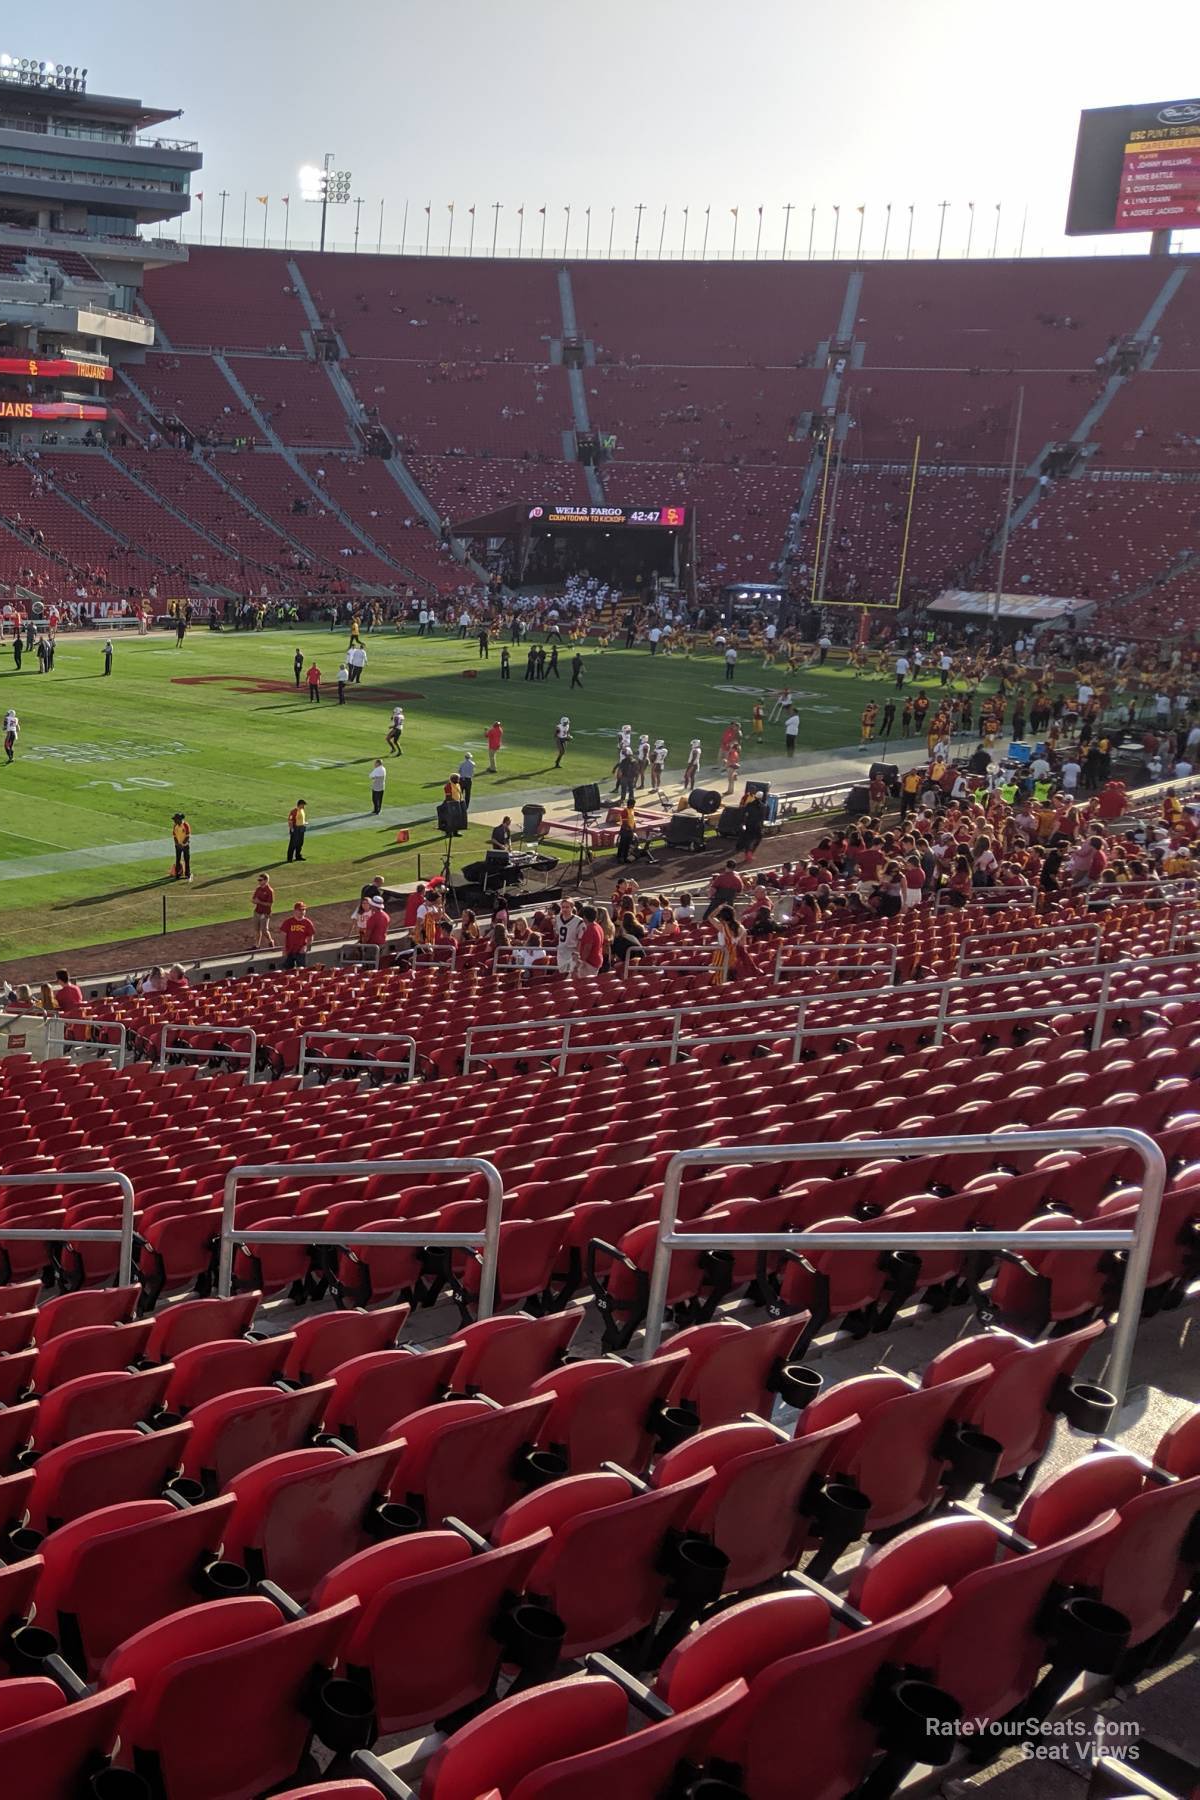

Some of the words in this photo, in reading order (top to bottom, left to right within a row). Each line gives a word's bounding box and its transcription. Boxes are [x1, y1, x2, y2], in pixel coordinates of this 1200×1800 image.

[1130, 130, 1146, 141] USC
[1147, 129, 1169, 139] PUNT
[1162, 157, 1192, 167] WILLIAMS
[1151, 171, 1174, 180] BATTLE
[1133, 184, 1156, 193] CURTIS
[1155, 206, 1185, 216] JACKSON
[77, 362, 105, 380] TROJANS
[555, 506, 588, 515] WELLS
[590, 507, 622, 516] FARGO
[600, 515, 626, 523] KICKOFF
[631, 511, 660, 522] 42:47
[290, 924, 306, 932] USC
[558, 926, 568, 939] 9
